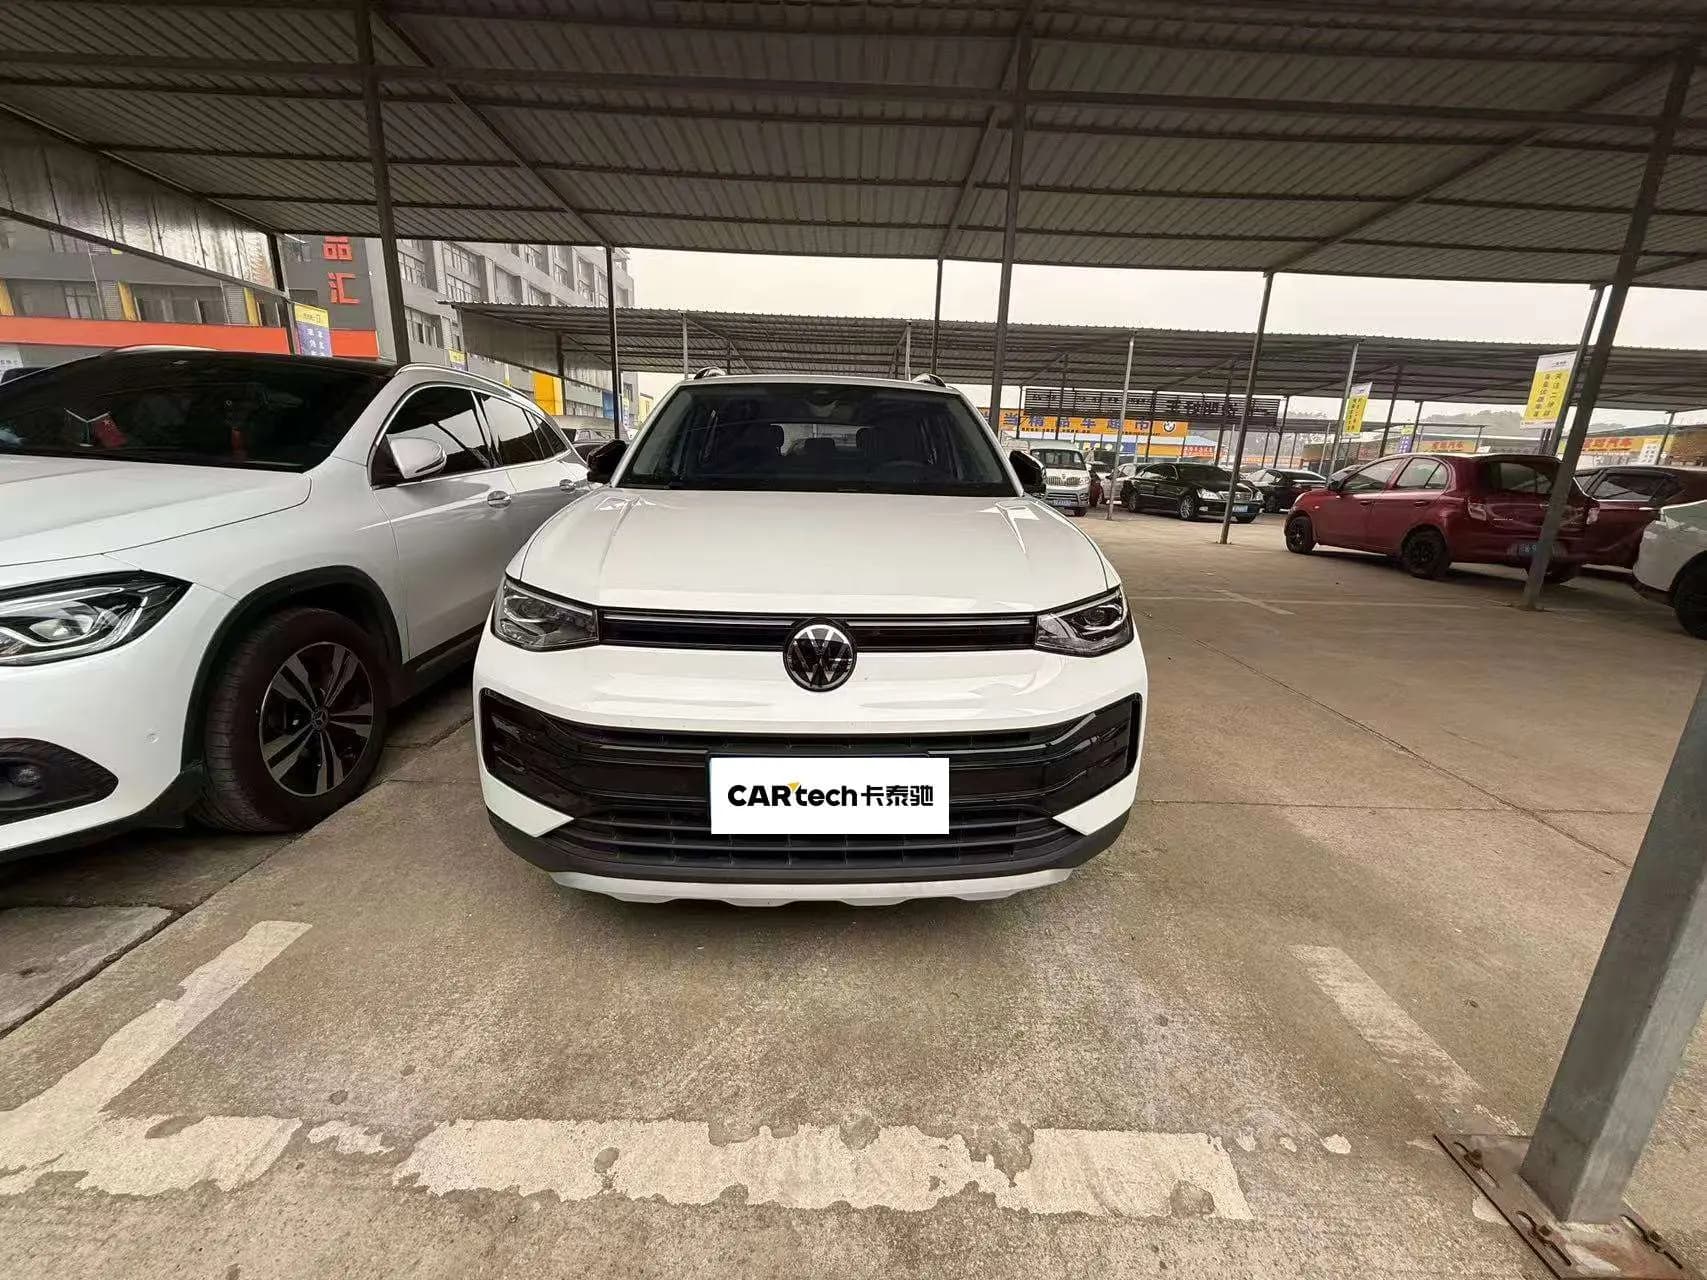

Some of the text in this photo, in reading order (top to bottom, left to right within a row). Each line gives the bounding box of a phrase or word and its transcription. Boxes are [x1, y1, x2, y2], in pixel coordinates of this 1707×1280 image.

[322, 236, 360, 304] 品汇
[984, 411, 1149, 430] 当精品车超市
